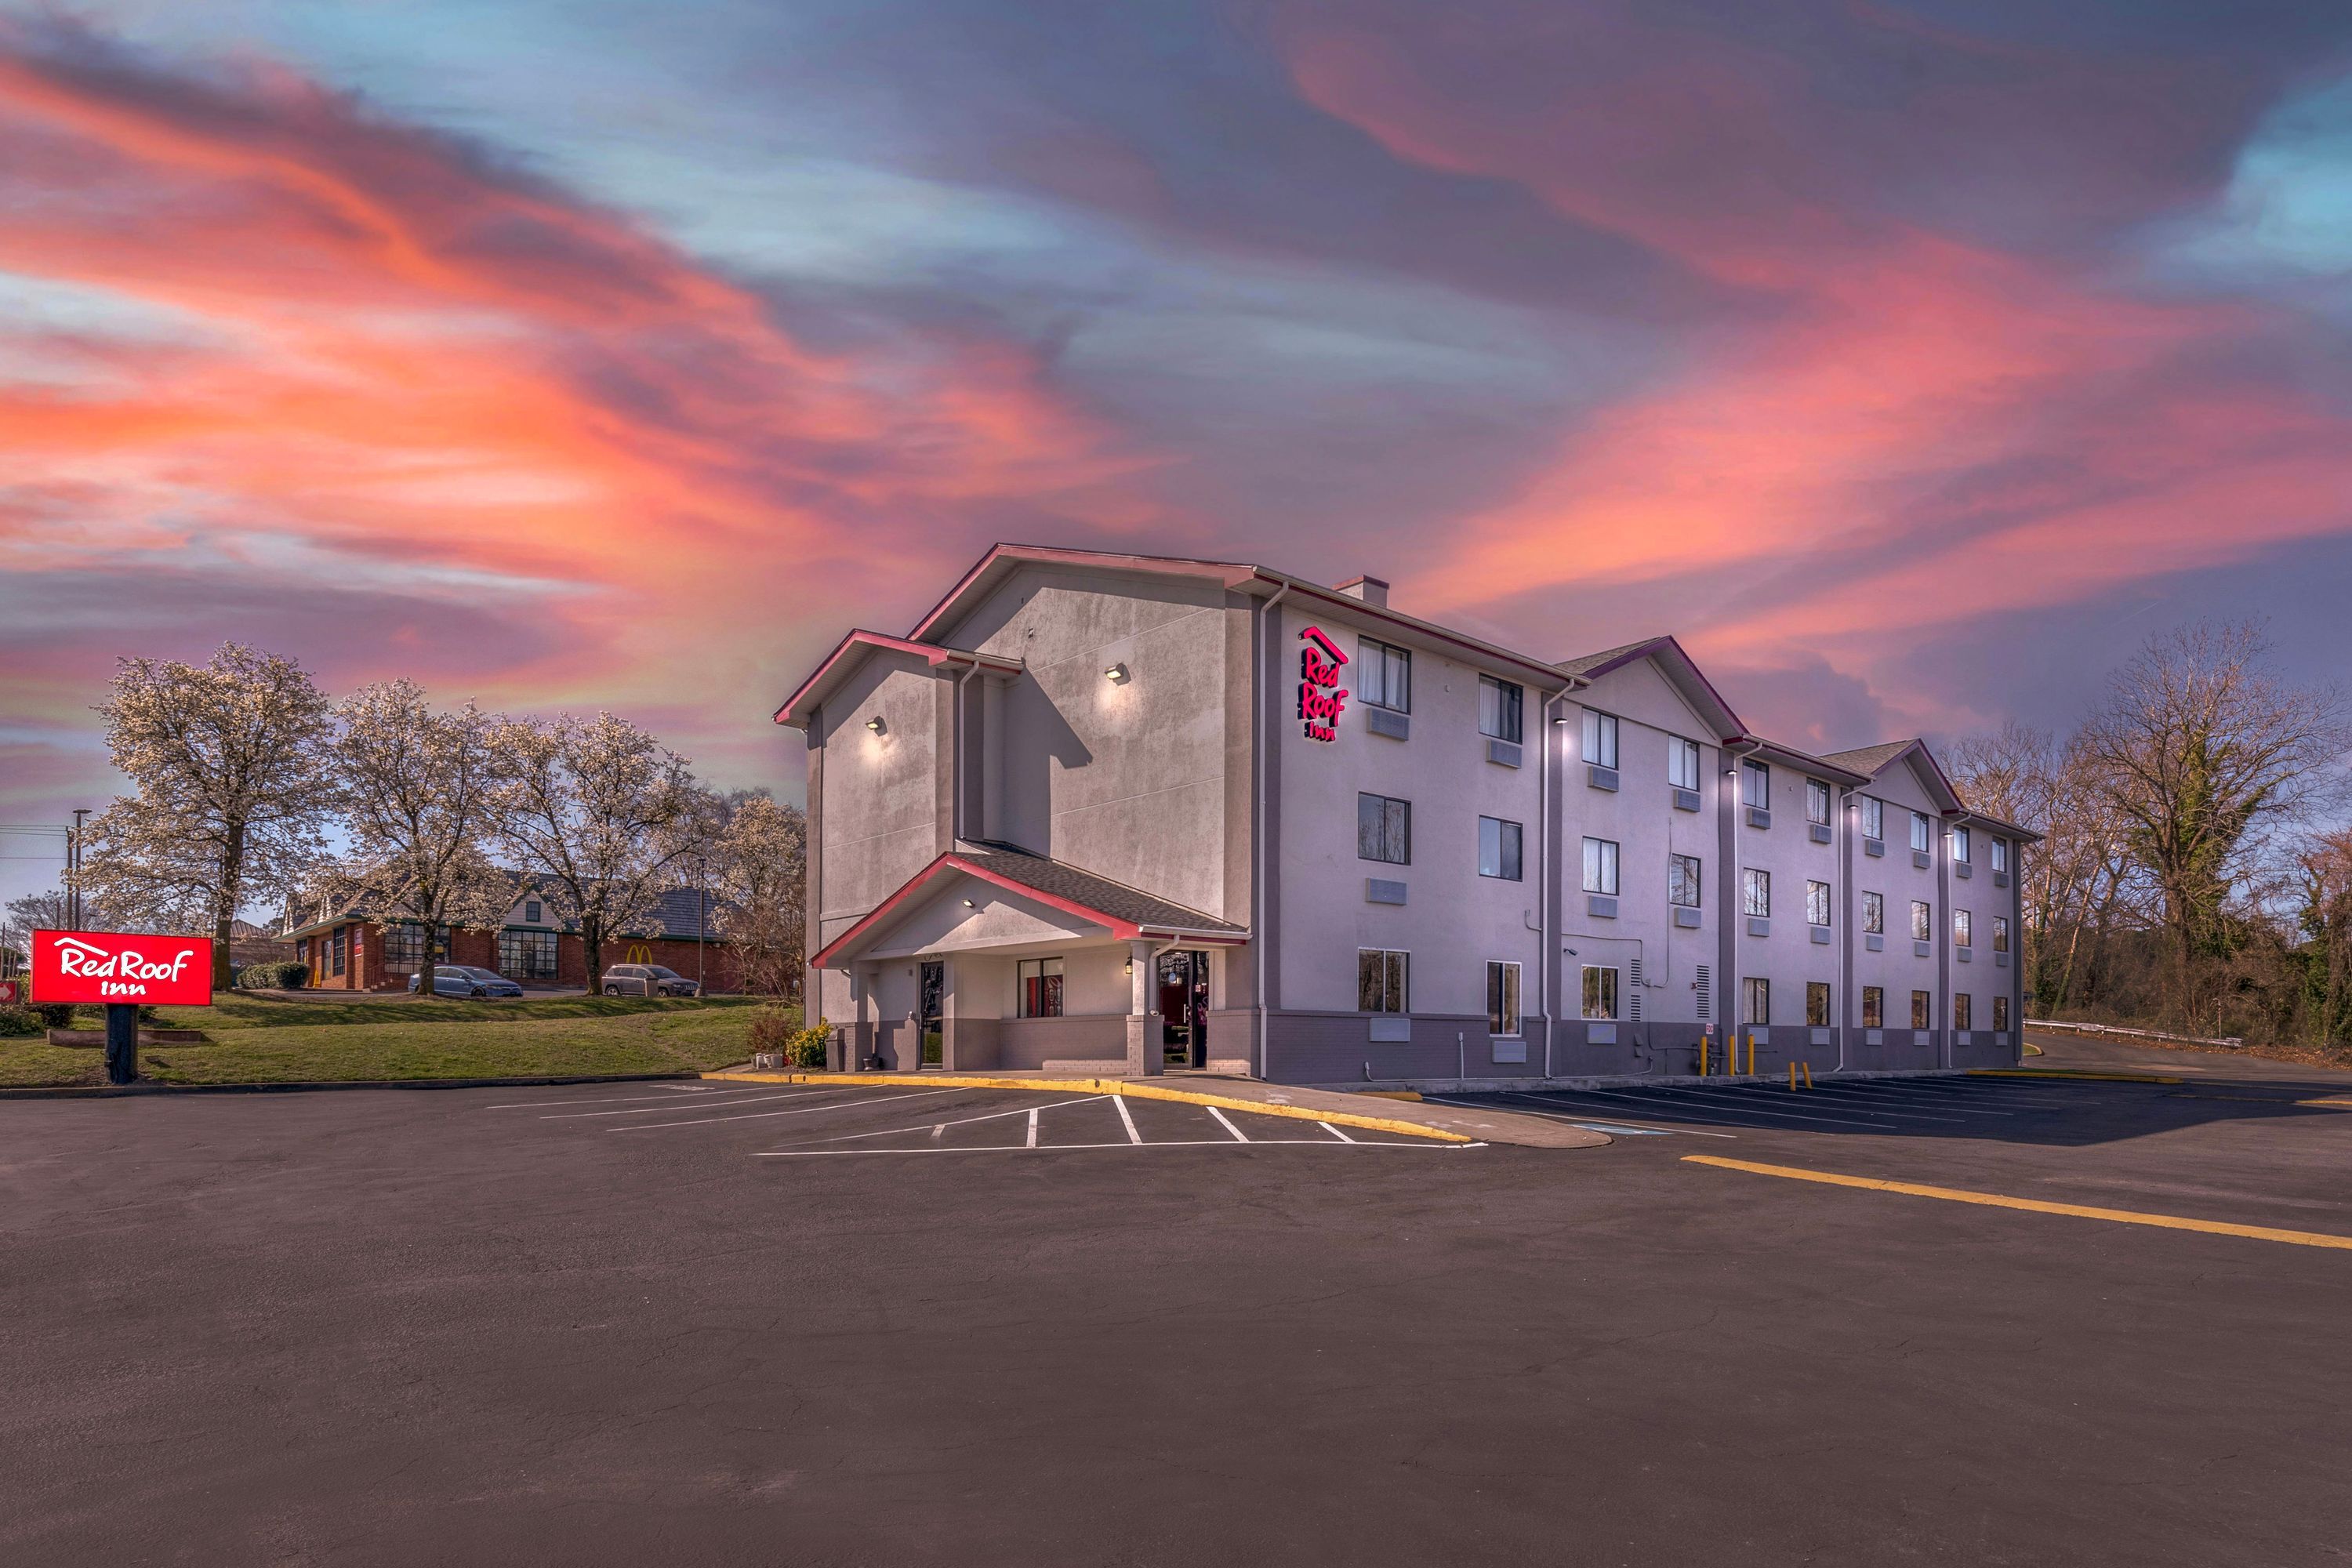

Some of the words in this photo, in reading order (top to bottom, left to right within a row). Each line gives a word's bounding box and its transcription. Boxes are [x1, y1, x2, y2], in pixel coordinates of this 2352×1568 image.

[1305, 646, 1340, 688] Red
[1301, 681, 1348, 728] Roof
[61, 948, 118, 977] Red
[121, 950, 194, 982] Roof
